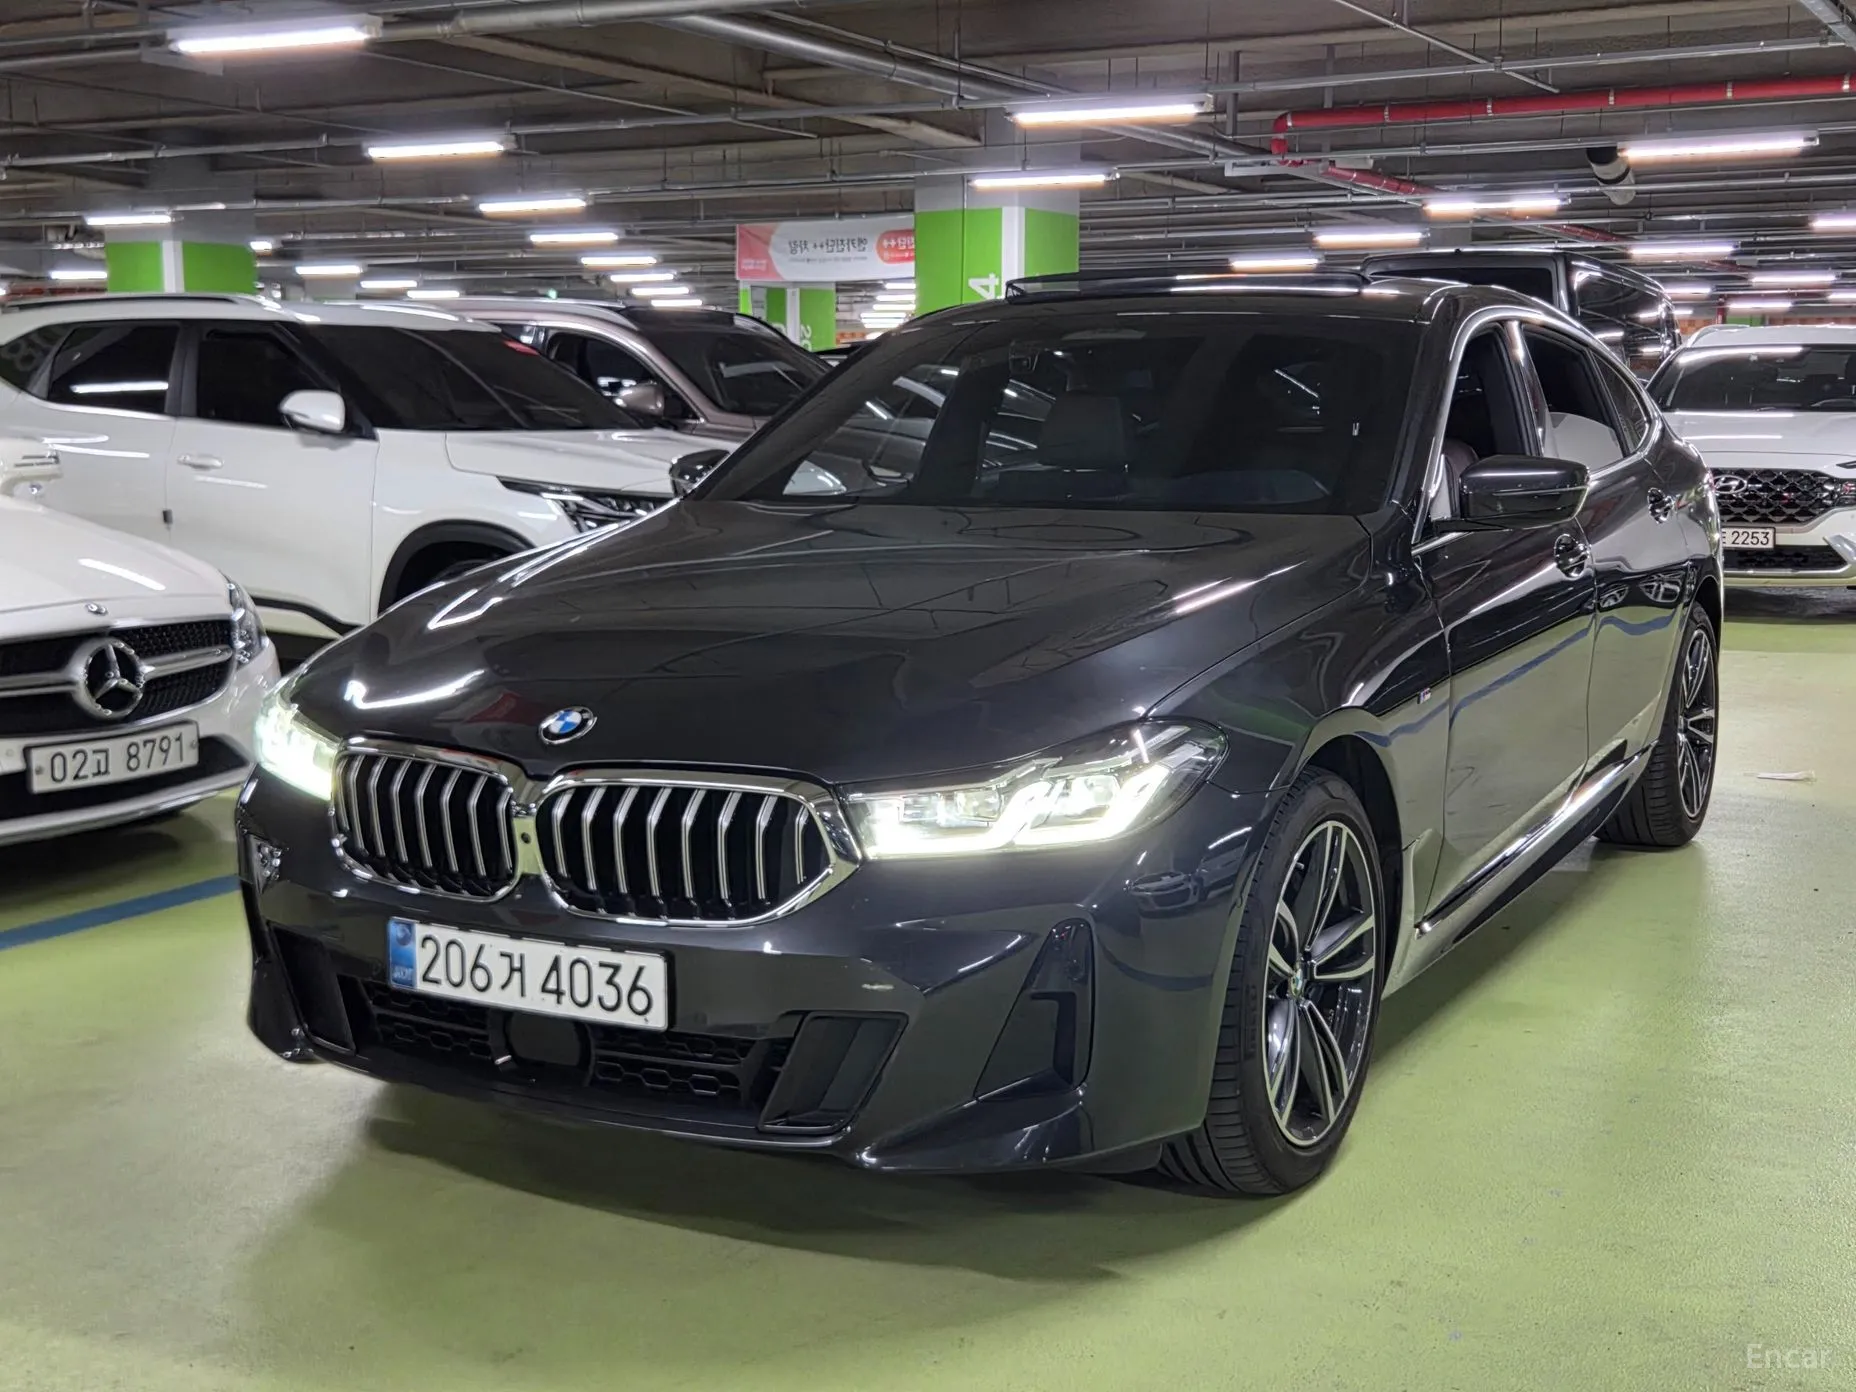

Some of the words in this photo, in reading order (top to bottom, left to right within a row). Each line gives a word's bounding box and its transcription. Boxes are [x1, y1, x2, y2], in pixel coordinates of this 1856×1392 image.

[1731, 530, 1770, 546] 2253
[126, 732, 184, 772] 8791
[421, 934, 526, 998] 206거
[541, 954, 653, 1017] 4036
